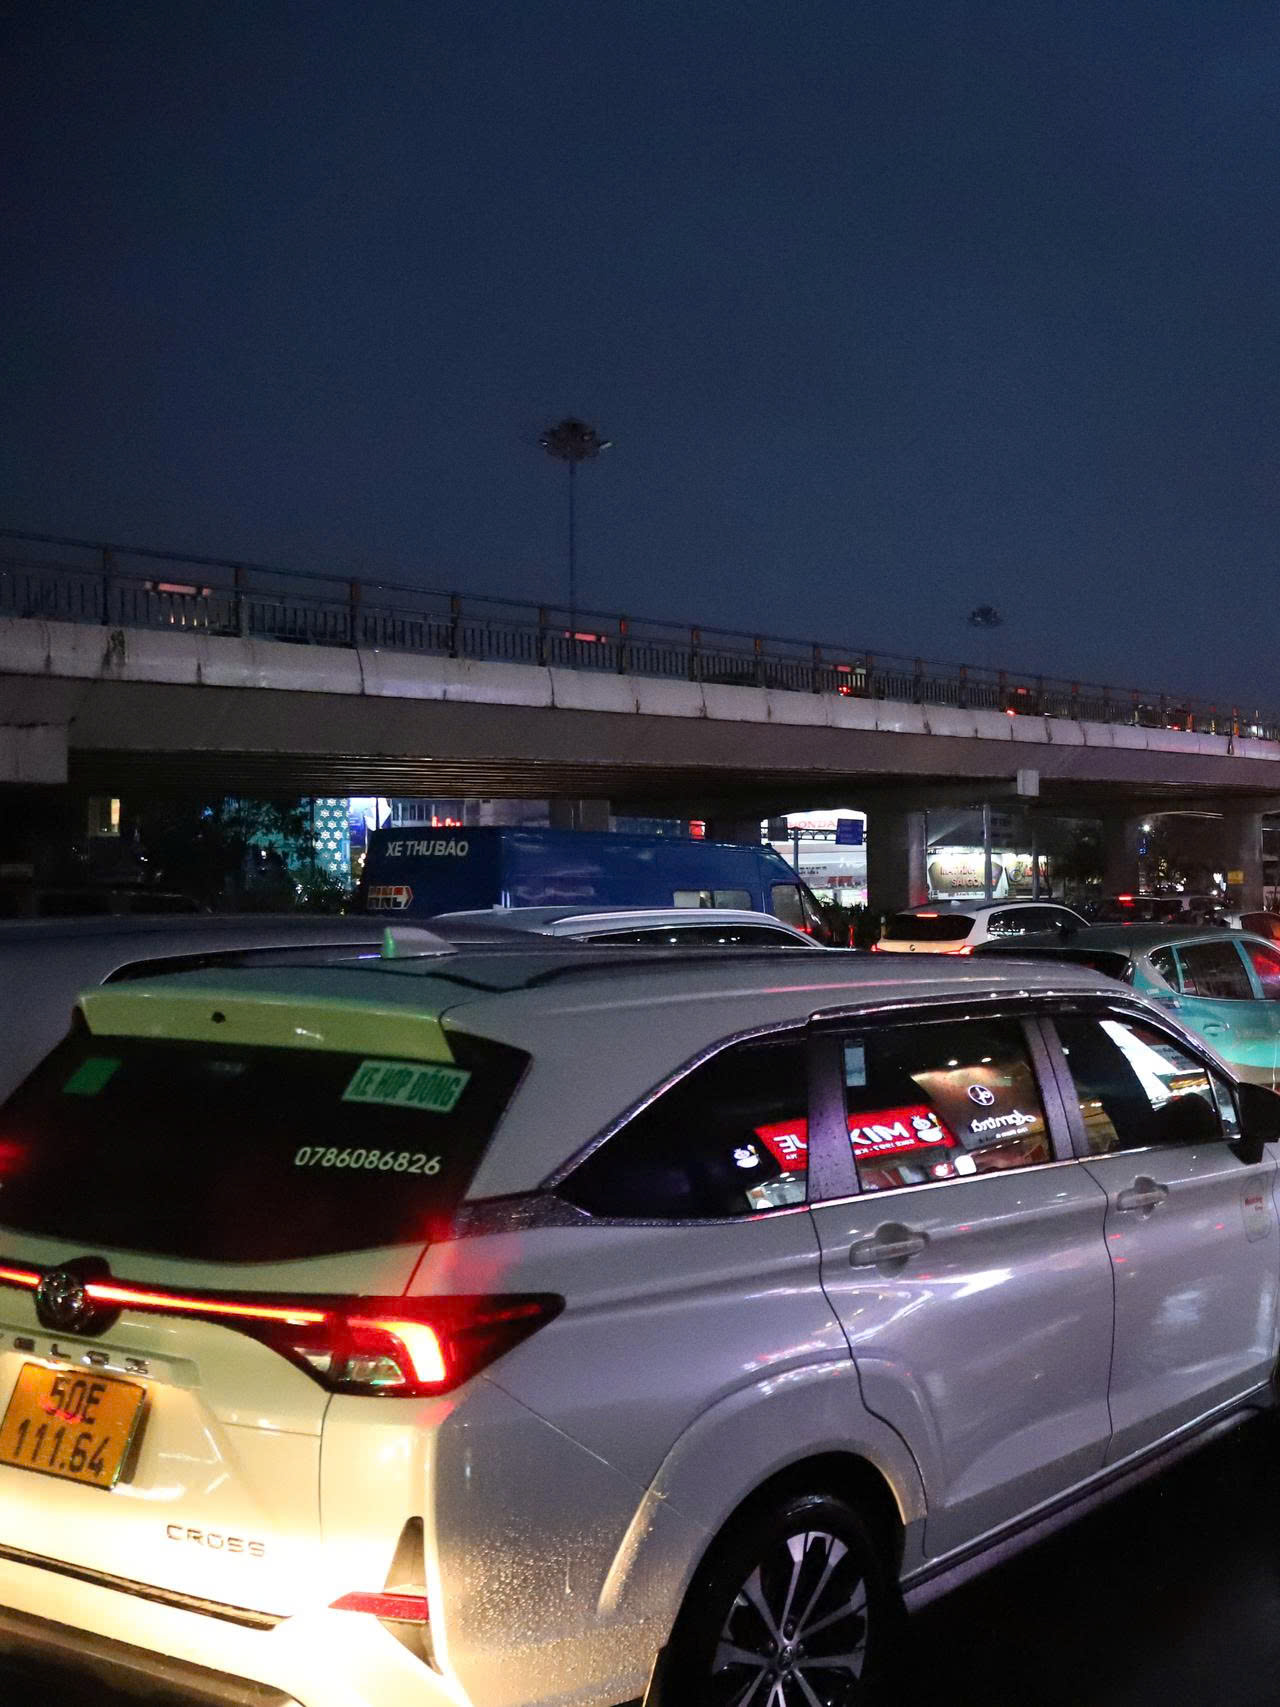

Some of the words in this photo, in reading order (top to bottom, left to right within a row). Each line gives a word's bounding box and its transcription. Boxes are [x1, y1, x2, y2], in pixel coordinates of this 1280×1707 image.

[386, 841, 404, 857] XE
[351, 1067, 380, 1097] XE
[294, 1147, 442, 1175] 0786086826
[0, 1333, 150, 1375] ELOZ
[13, 1418, 110, 1478] 111.64
[166, 1523, 265, 1558] CROSS
